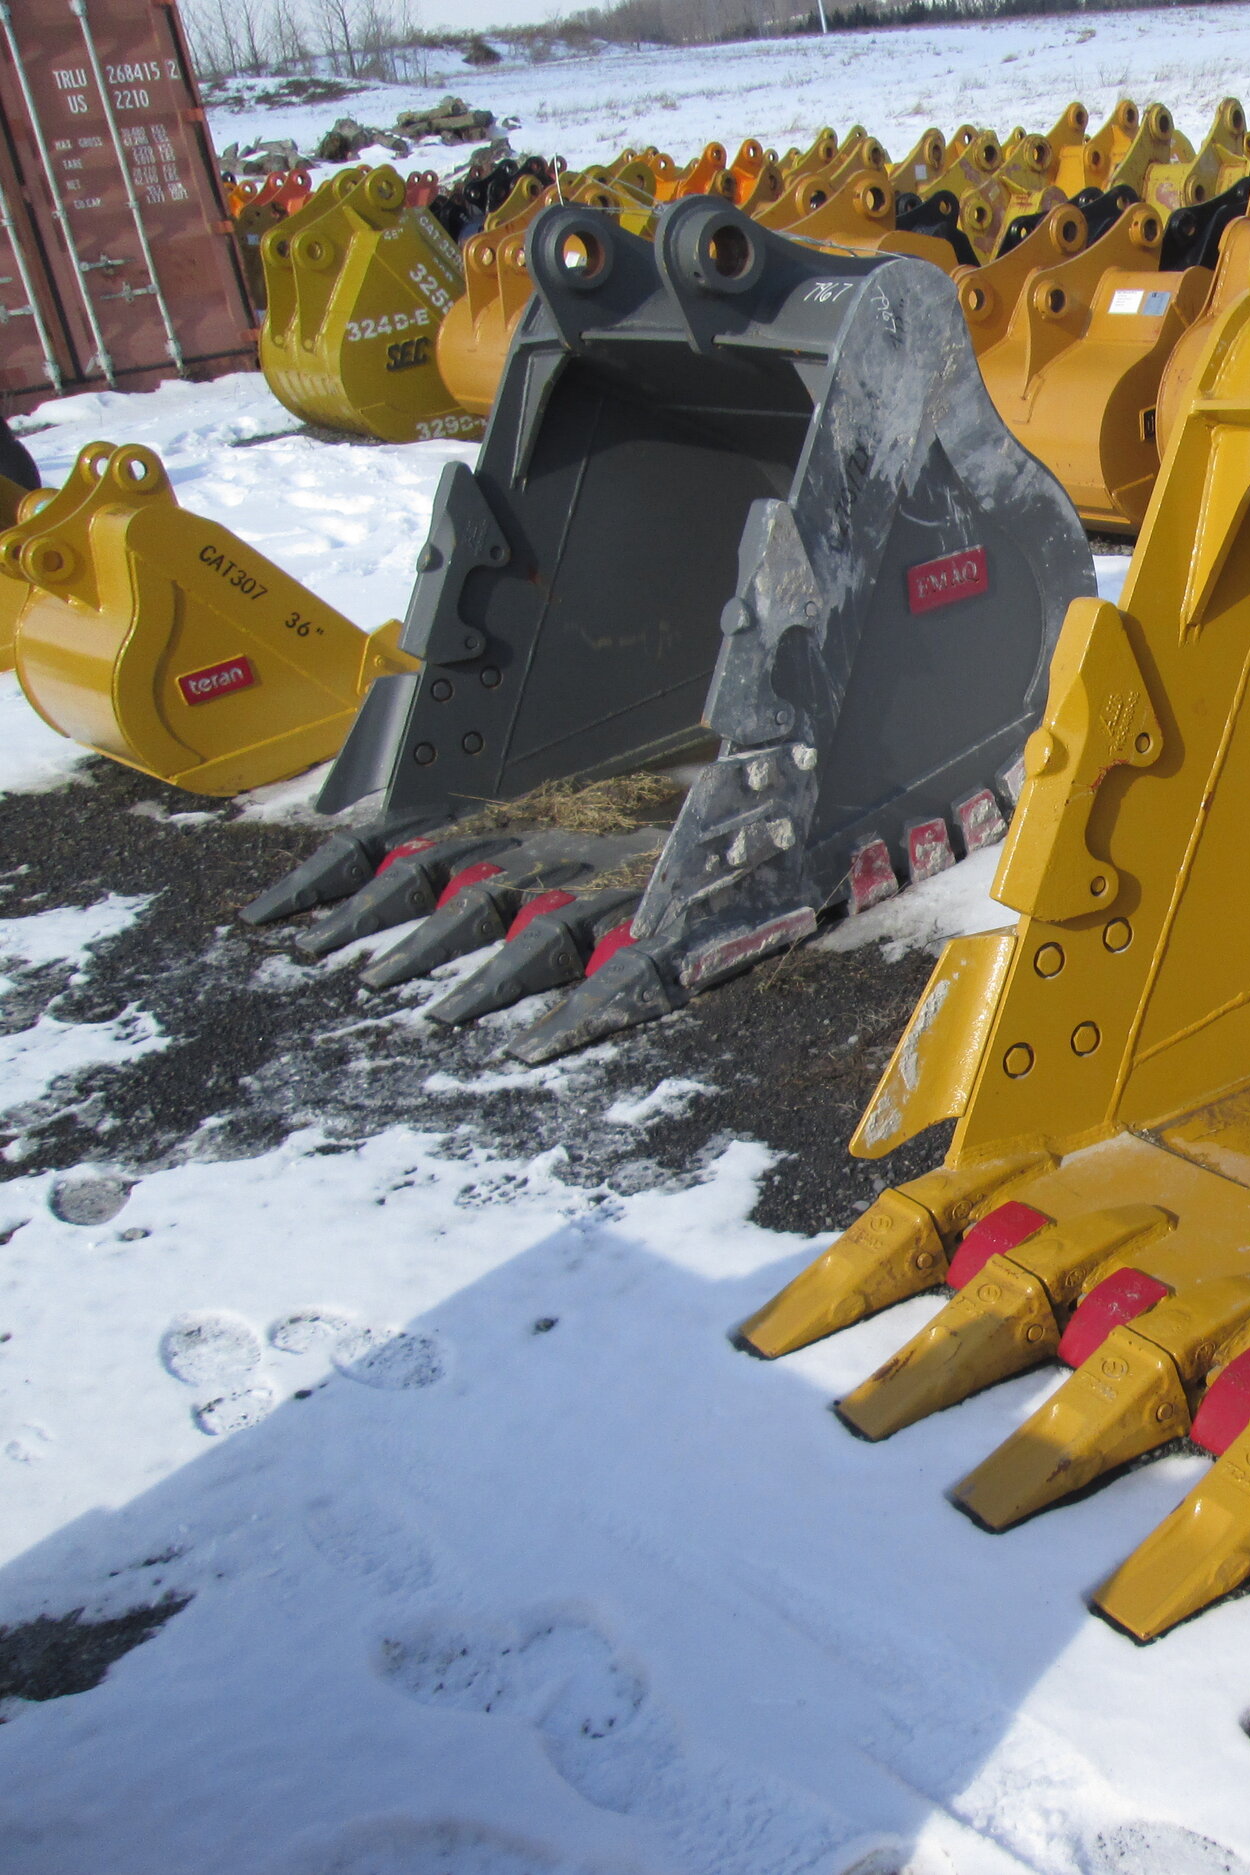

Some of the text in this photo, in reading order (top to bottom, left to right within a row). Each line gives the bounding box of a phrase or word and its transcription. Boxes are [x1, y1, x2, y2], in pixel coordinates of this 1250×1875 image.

[52, 61, 178, 89] TRLU 268415 2
[67, 90, 149, 114] US 2210
[420, 216, 440, 239] CAT
[804, 282, 853, 303] 7967
[347, 308, 430, 341] 324D-E
[386, 336, 433, 372] SEC
[199, 545, 325, 637] CAT307 36"
[189, 667, 244, 695] teran
